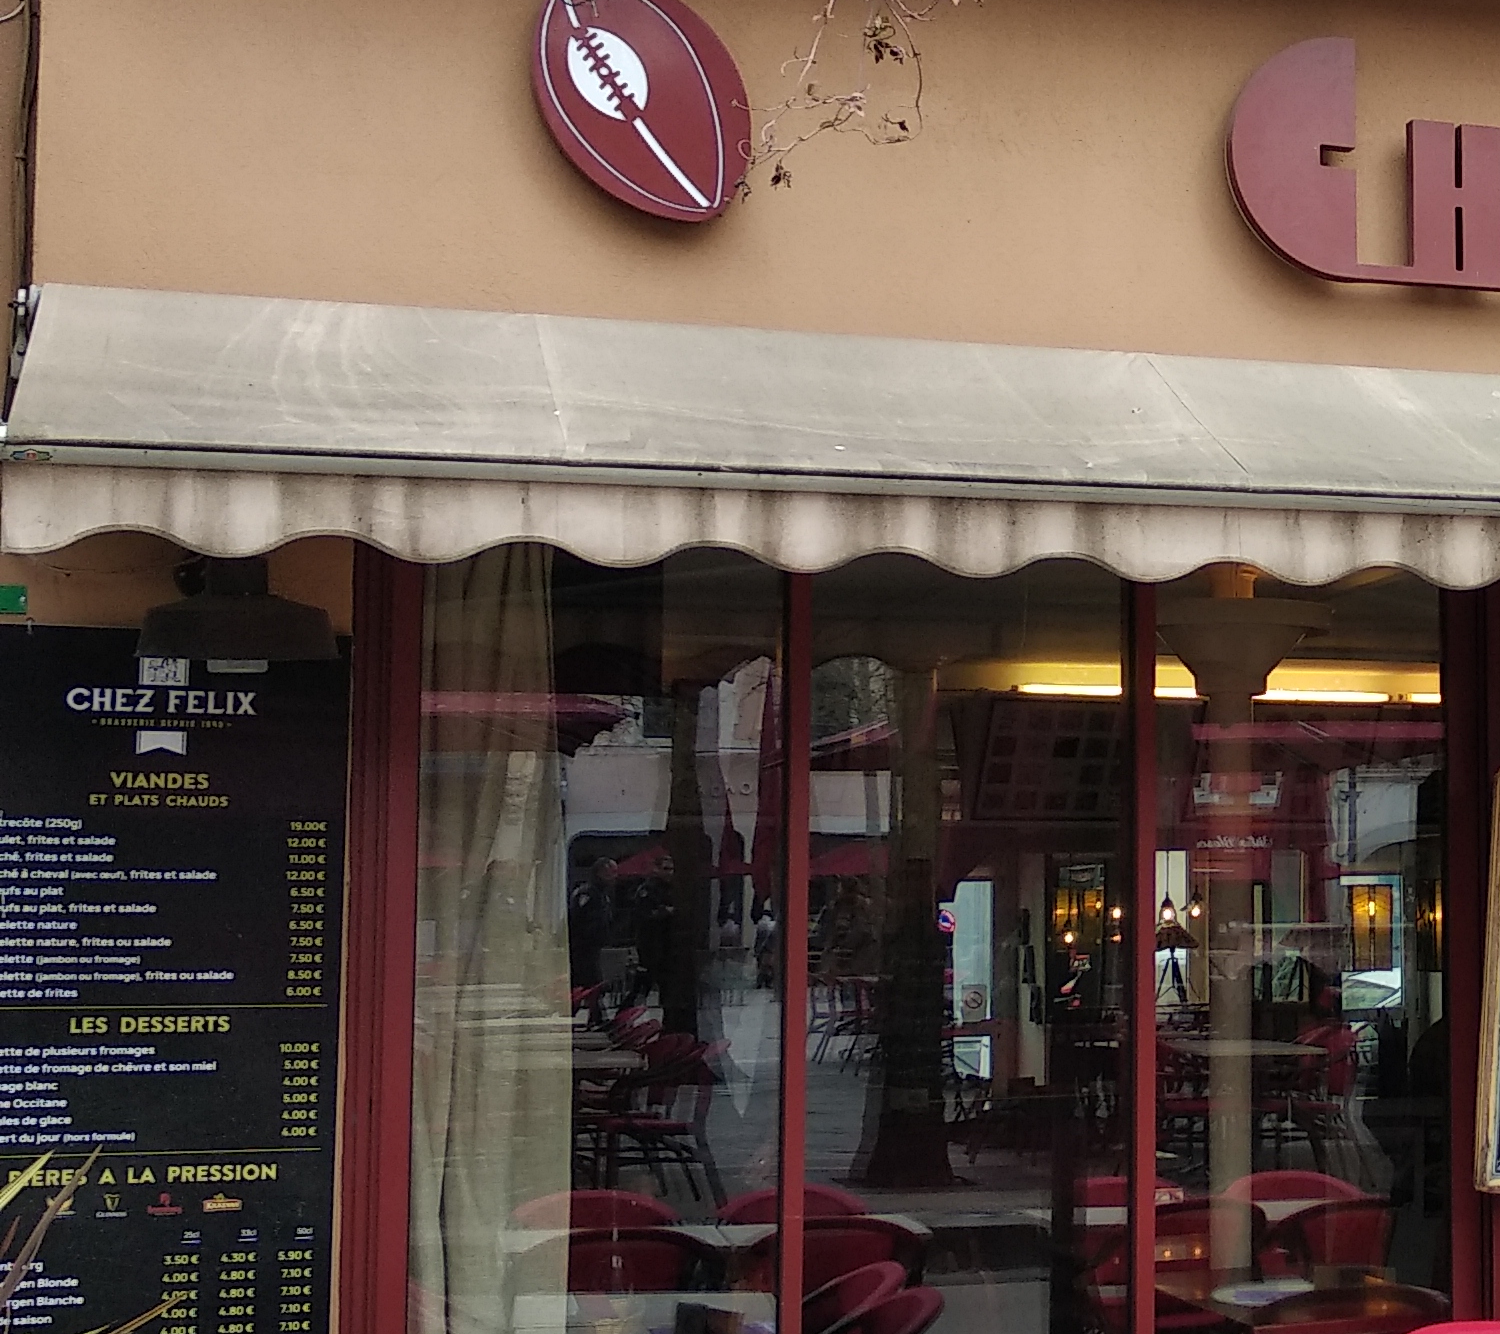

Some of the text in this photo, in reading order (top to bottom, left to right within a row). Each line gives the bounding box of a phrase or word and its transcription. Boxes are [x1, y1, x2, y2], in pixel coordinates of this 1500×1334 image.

[66, 687, 258, 716] CHEZ FELIX
[109, 771, 210, 789] VIANDES
[89, 794, 229, 807] ET PLATS CHAUDS
[27, 835, 116, 845] frites et salade
[286, 837, 327, 848] 12.00 €
[24, 852, 114, 862] frites et salade
[288, 854, 327, 864] 11.00 €
[30, 869, 69, 879] cheval
[129, 869, 162, 879] frites
[163, 869, 178, 879] et
[178, 869, 218, 879] salade
[285, 870, 326, 881] 12.00 €
[22, 886, 65, 898] au plat
[289, 887, 326, 897] 6.50 €
[22, 903, 158, 915] au plat, frites et salade
[290, 904, 325, 914] 7.50 €
[36, 920, 78, 930] nature
[288, 920, 324, 930] 6.50 €
[81, 936, 115, 947] frites
[116, 936, 132, 947] ou
[133, 936, 172, 947] salade
[289, 937, 324, 947] 7.50 €
[289, 954, 323, 964] 7.50 €
[144, 971, 177, 981] frites
[178, 971, 195, 981] ou
[195, 971, 235, 981] salade
[287, 970, 322, 980] 8.50 €
[27, 988, 79, 998] de frites
[285, 987, 322, 997] 6.00 €
[69, 1015, 231, 1034] LES DESSERTS
[24, 1045, 156, 1058] de plusieurs fromages
[279, 1042, 310, 1053] 10.00
[24, 1061, 217, 1076] de fromage de chèvre et son miel
[283, 1059, 310, 1070] 5.00
[25, 1080, 59, 1091] blanc
[282, 1076, 309, 1086] 4.00
[282, 1092, 309, 1103] 5.00
[13, 1098, 68, 1109] Occitane
[281, 1109, 308, 1120] 4.00
[21, 1115, 73, 1127] de glace
[18, 1133, 35, 1143] du
[36, 1133, 61, 1145] jour
[98, 1163, 278, 1185] A LA PRESSION
[163, 1254, 189, 1265] 3.50
[221, 1252, 246, 1263] 4.30
[277, 1250, 303, 1261] 5.90
[162, 1272, 188, 1283] 4.00
[219, 1270, 245, 1281] 4.80
[280, 1268, 302, 1278] 7.10
[36, 1277, 79, 1288] Blonde
[219, 1288, 245, 1299] 4.80
[280, 1286, 302, 1296] 7.10
[36, 1295, 85, 1307] Blanche
[218, 1305, 244, 1316] 4.80
[279, 1303, 301, 1314] 7.10
[12, 1314, 53, 1326] saison
[217, 1323, 243, 1334] 4.80
[278, 1321, 300, 1331] 7.10
